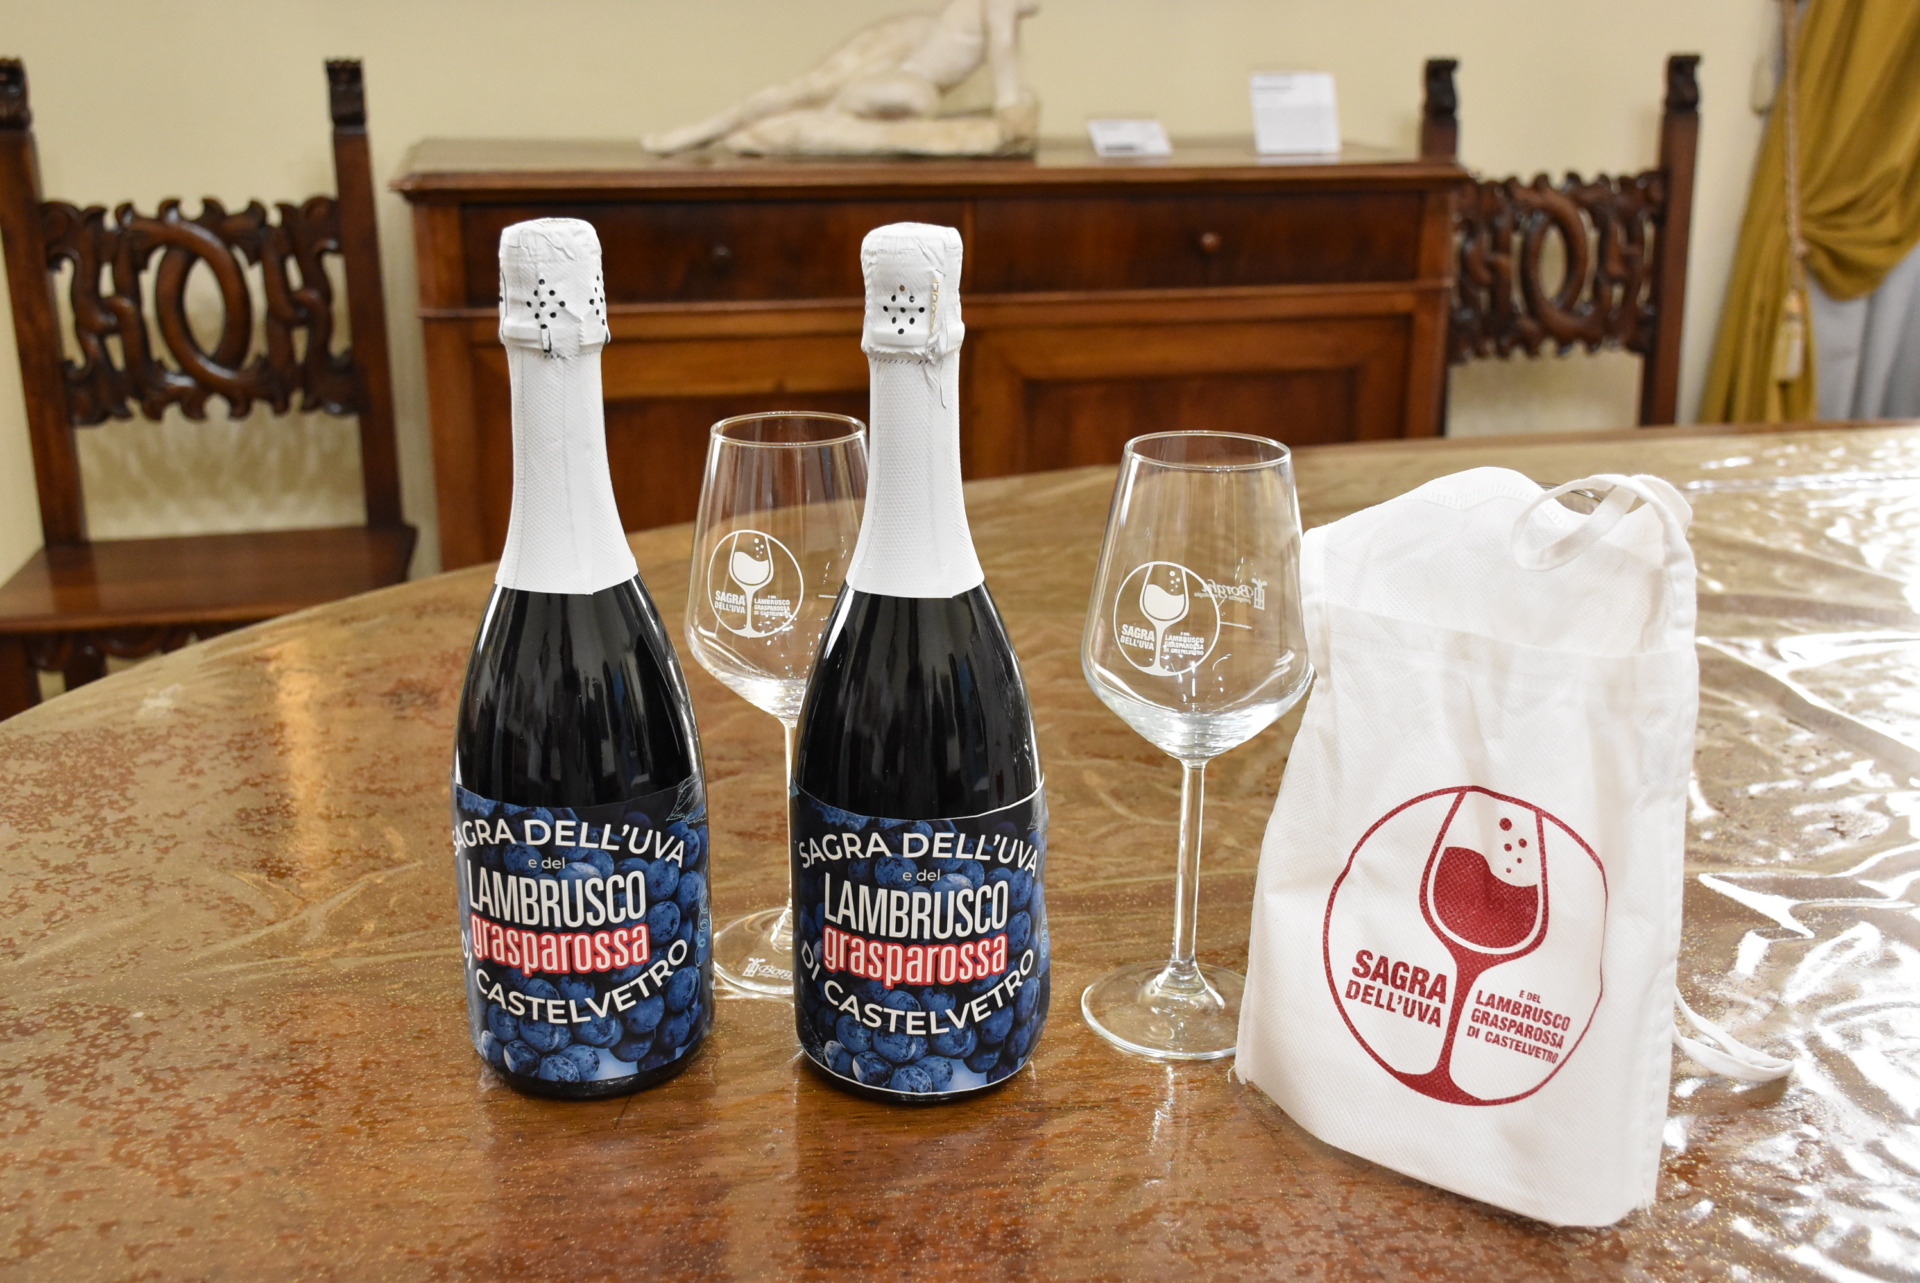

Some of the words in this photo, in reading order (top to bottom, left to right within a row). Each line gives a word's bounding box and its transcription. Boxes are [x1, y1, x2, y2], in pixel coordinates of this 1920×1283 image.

[715, 601, 745, 614] DELL'UVA
[716, 590, 745, 606] SAGRA
[1120, 635, 1154, 650] DELL'UVA
[1121, 624, 1155, 642] SAGRA
[524, 819, 685, 868] DELL'UVA
[528, 859, 537, 868] e
[541, 857, 566, 869] del
[799, 832, 891, 868] SAGRA
[902, 832, 1037, 877] DELL'UVA
[467, 860, 646, 928] LAMBRUSCO
[902, 872, 912, 882] e
[916, 869, 941, 882] del
[824, 872, 1008, 939] LAMBRUSCO
[471, 913, 649, 976] grasparossa
[823, 926, 1007, 987] grasparossa
[476, 939, 688, 1024] CASTELVETRO
[801, 940, 821, 981] DI
[824, 949, 1033, 1035] CASTELVETRO
[1351, 949, 1447, 1005] SAGRA
[1519, 990, 1525, 998] E
[1526, 992, 1541, 1004] DEL
[1345, 979, 1441, 1028] DELL'UVA
[1475, 989, 1571, 1031] LAMBRUSCO
[1467, 1025, 1480, 1039] DI
[1484, 1031, 1559, 1064] CASTELVETRO
[1471, 1008, 1564, 1049] GRASPAROSSA
